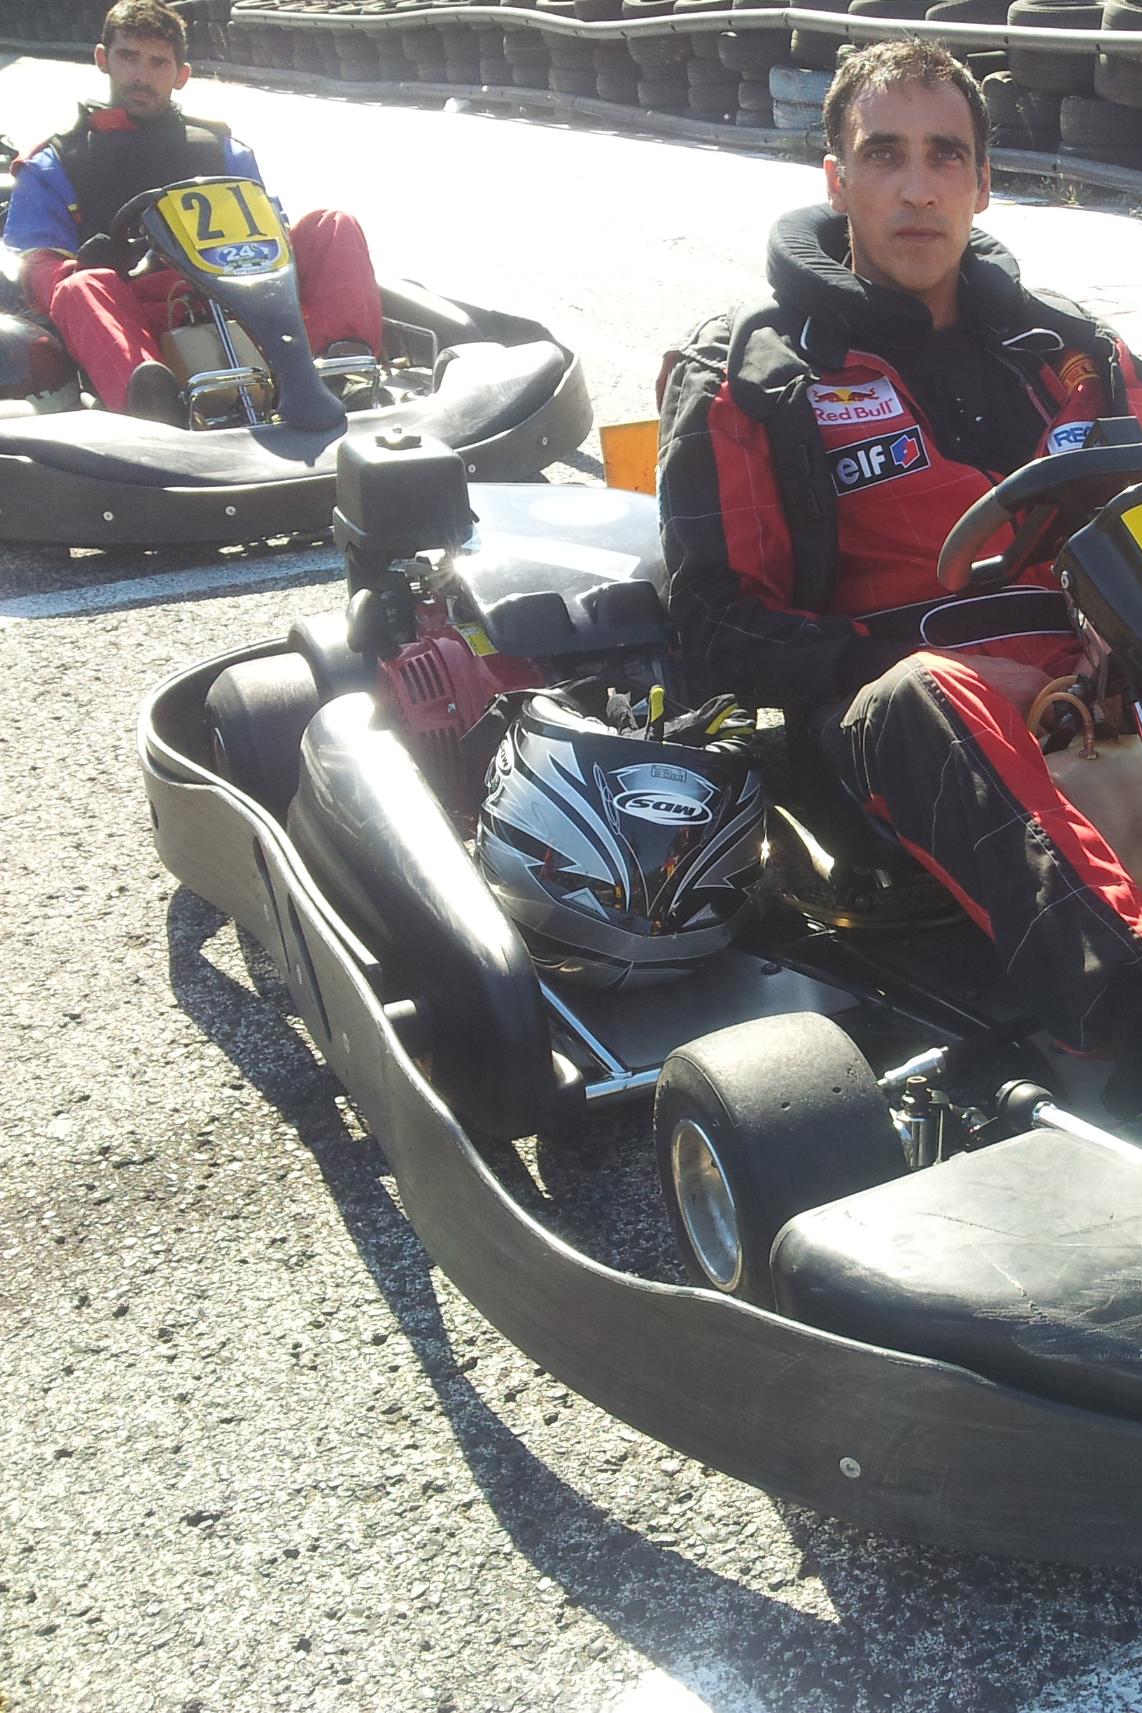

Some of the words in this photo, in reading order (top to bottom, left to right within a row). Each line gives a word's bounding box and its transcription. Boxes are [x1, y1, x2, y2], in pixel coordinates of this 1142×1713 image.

[180, 184, 268, 242] 21
[222, 244, 255, 262] 24
[814, 407, 852, 422] Red
[854, 399, 893, 419] Bull
[836, 444, 886, 485] elf
[628, 799, 697, 817] MDS
